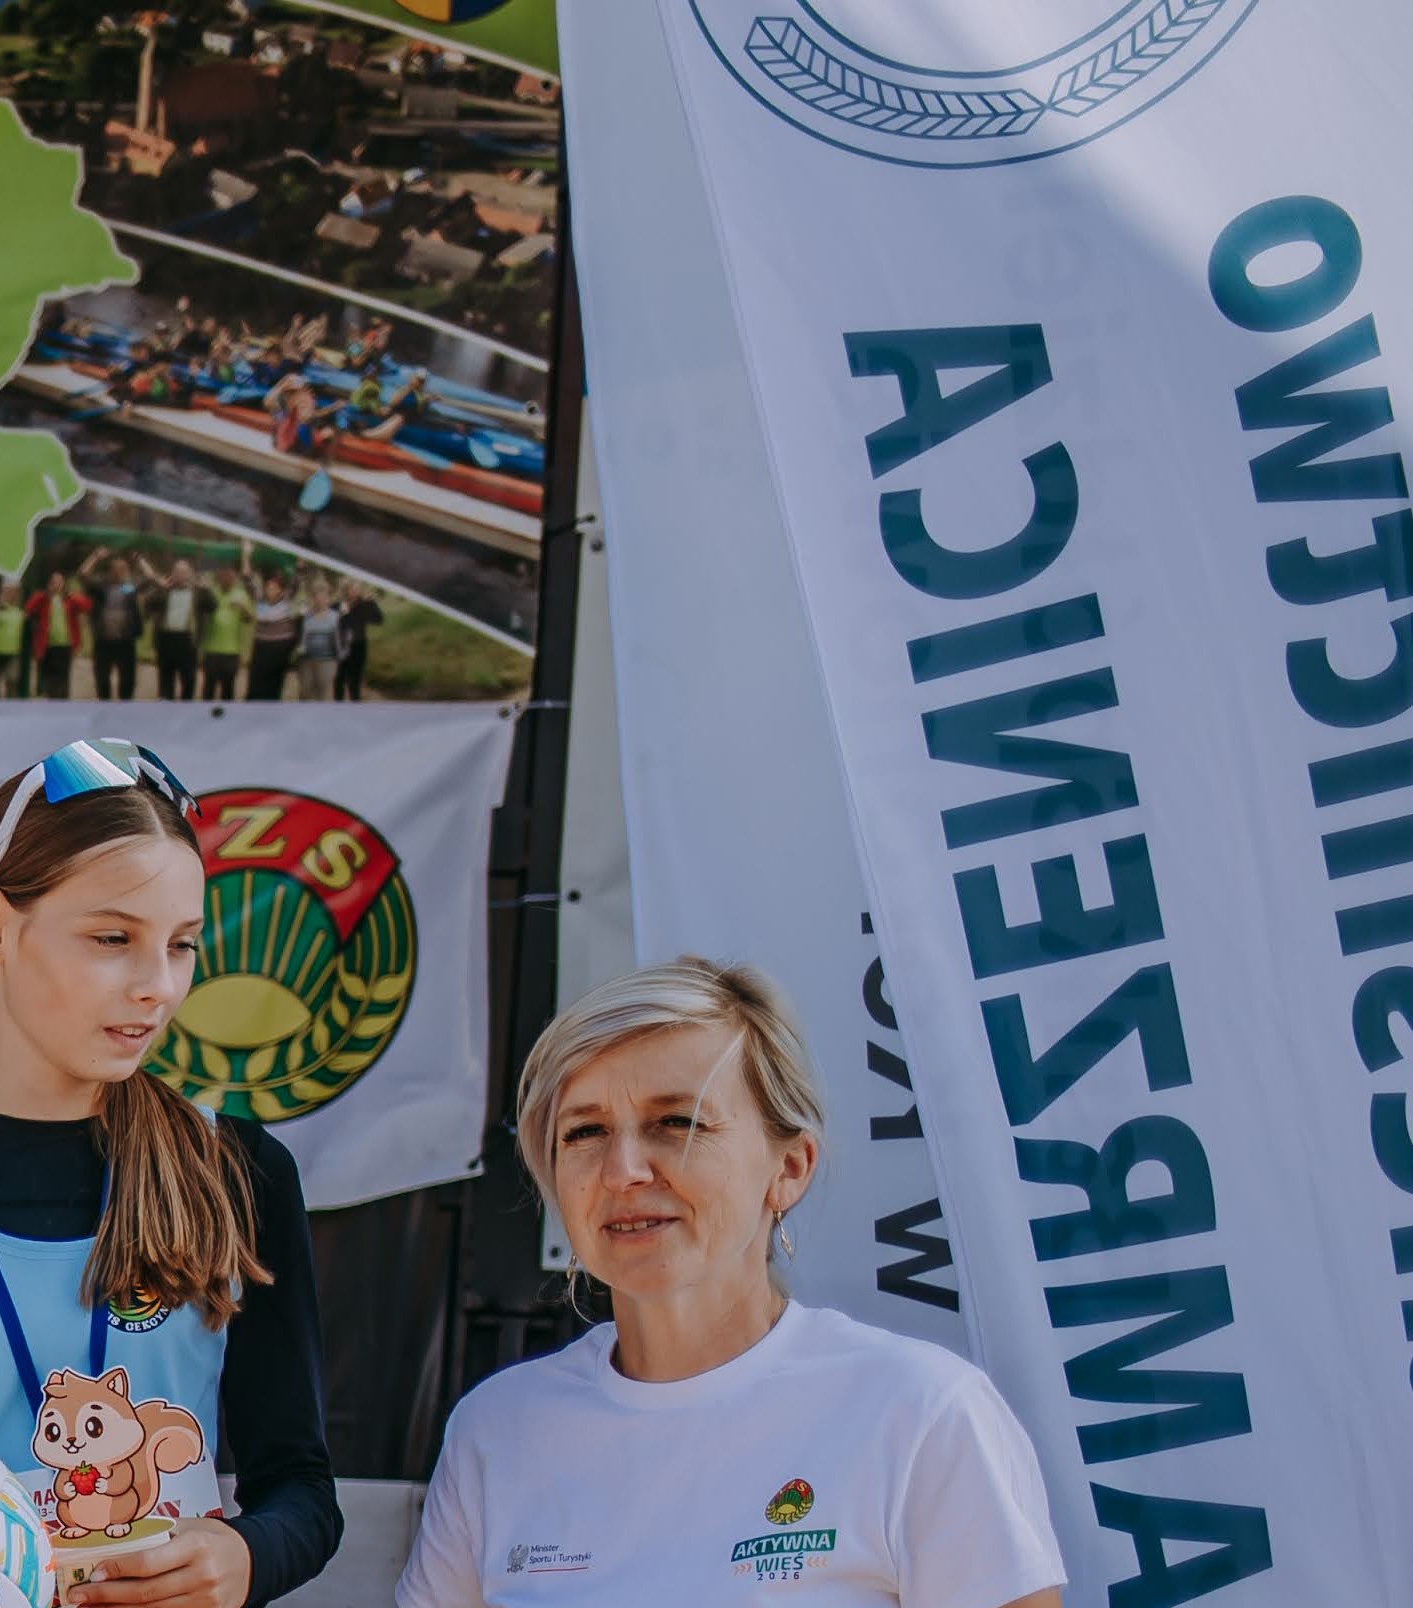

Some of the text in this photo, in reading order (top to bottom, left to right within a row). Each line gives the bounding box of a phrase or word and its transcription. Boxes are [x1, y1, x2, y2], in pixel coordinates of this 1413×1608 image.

[530, 1545, 560, 1553] Minister
[734, 1533, 831, 1559] AKTYWNA
[756, 1551, 804, 1573] WIEŚ
[757, 1571, 800, 1581] 2026
